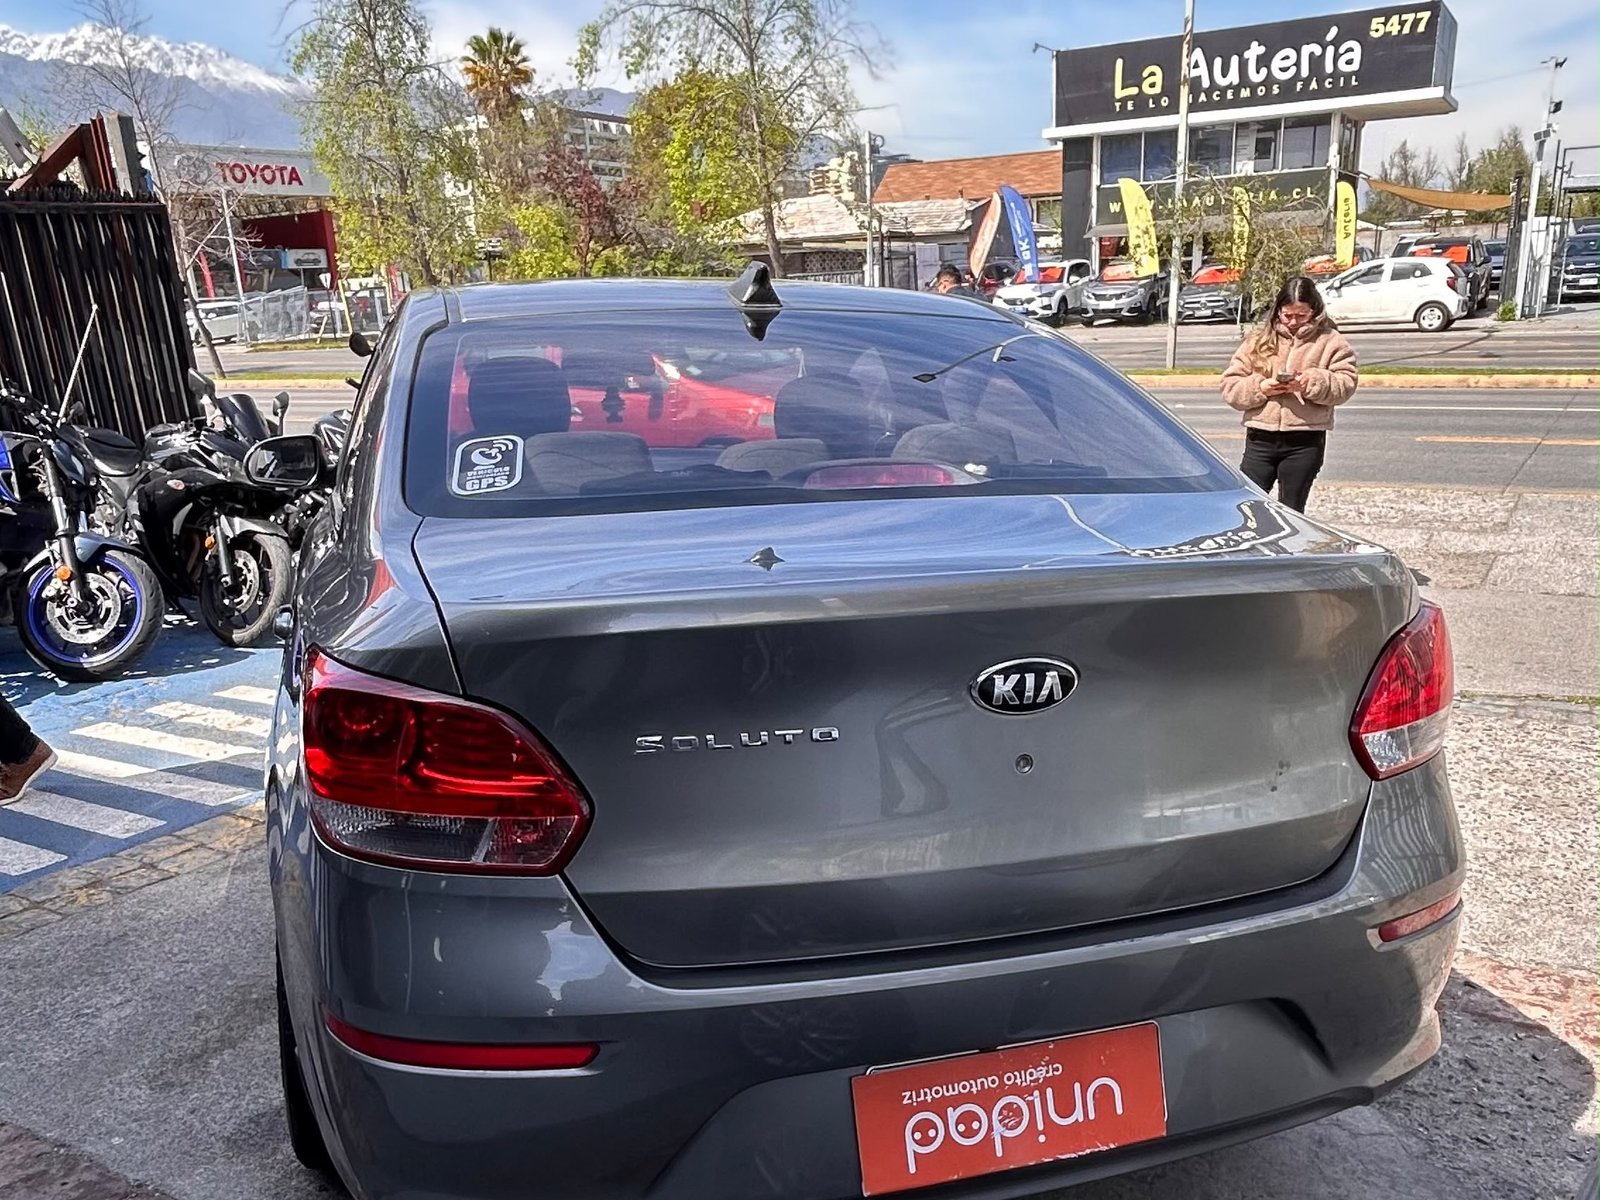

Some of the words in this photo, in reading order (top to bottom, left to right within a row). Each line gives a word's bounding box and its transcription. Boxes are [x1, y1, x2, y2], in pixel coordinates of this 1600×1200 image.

[1369, 10, 1432, 38] 5477
[1114, 57, 1163, 100] La
[1189, 25, 1362, 89] Autería
[1114, 100, 1135, 112] TE
[1148, 96, 1169, 108] LO
[1296, 75, 1359, 92] FÁCIL
[215, 162, 304, 186] TOYOTA
[465, 475, 509, 491] GPS
[992, 670, 1063, 706] KIA
[634, 726, 840, 755] SOLUTO
[1003, 1062, 1064, 1087] crédito
[901, 1074, 998, 1106] automotriz
[904, 1076, 1124, 1174] unidad
